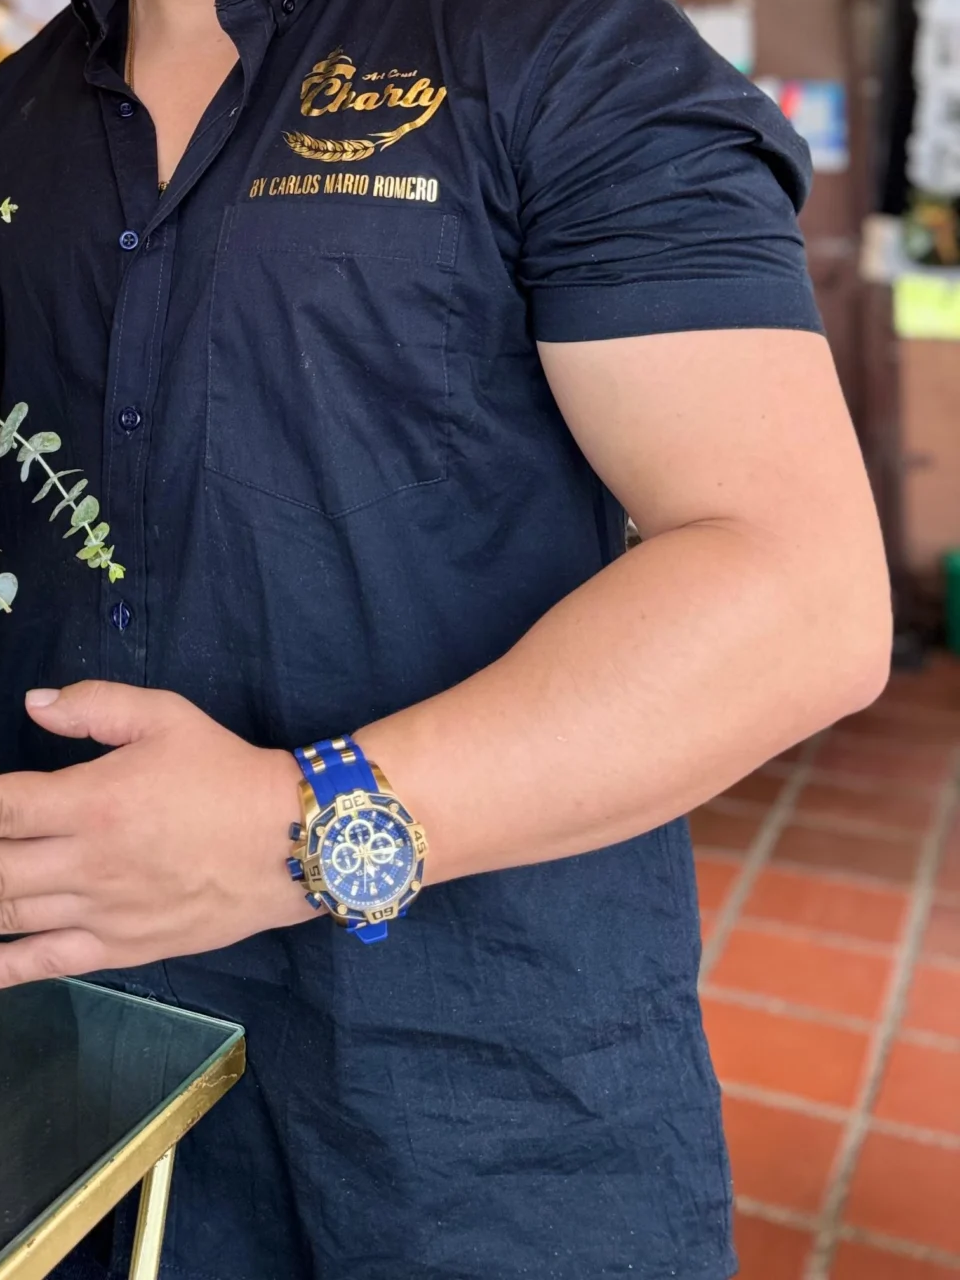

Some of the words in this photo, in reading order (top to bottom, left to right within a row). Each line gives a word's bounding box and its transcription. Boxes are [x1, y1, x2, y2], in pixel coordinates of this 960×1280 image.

[301, 74, 447, 132] Charly
[249, 176, 268, 198] BY
[268, 173, 322, 196] CARLOS
[323, 172, 369, 196] MARIO
[372, 175, 438, 203] ROMERO
